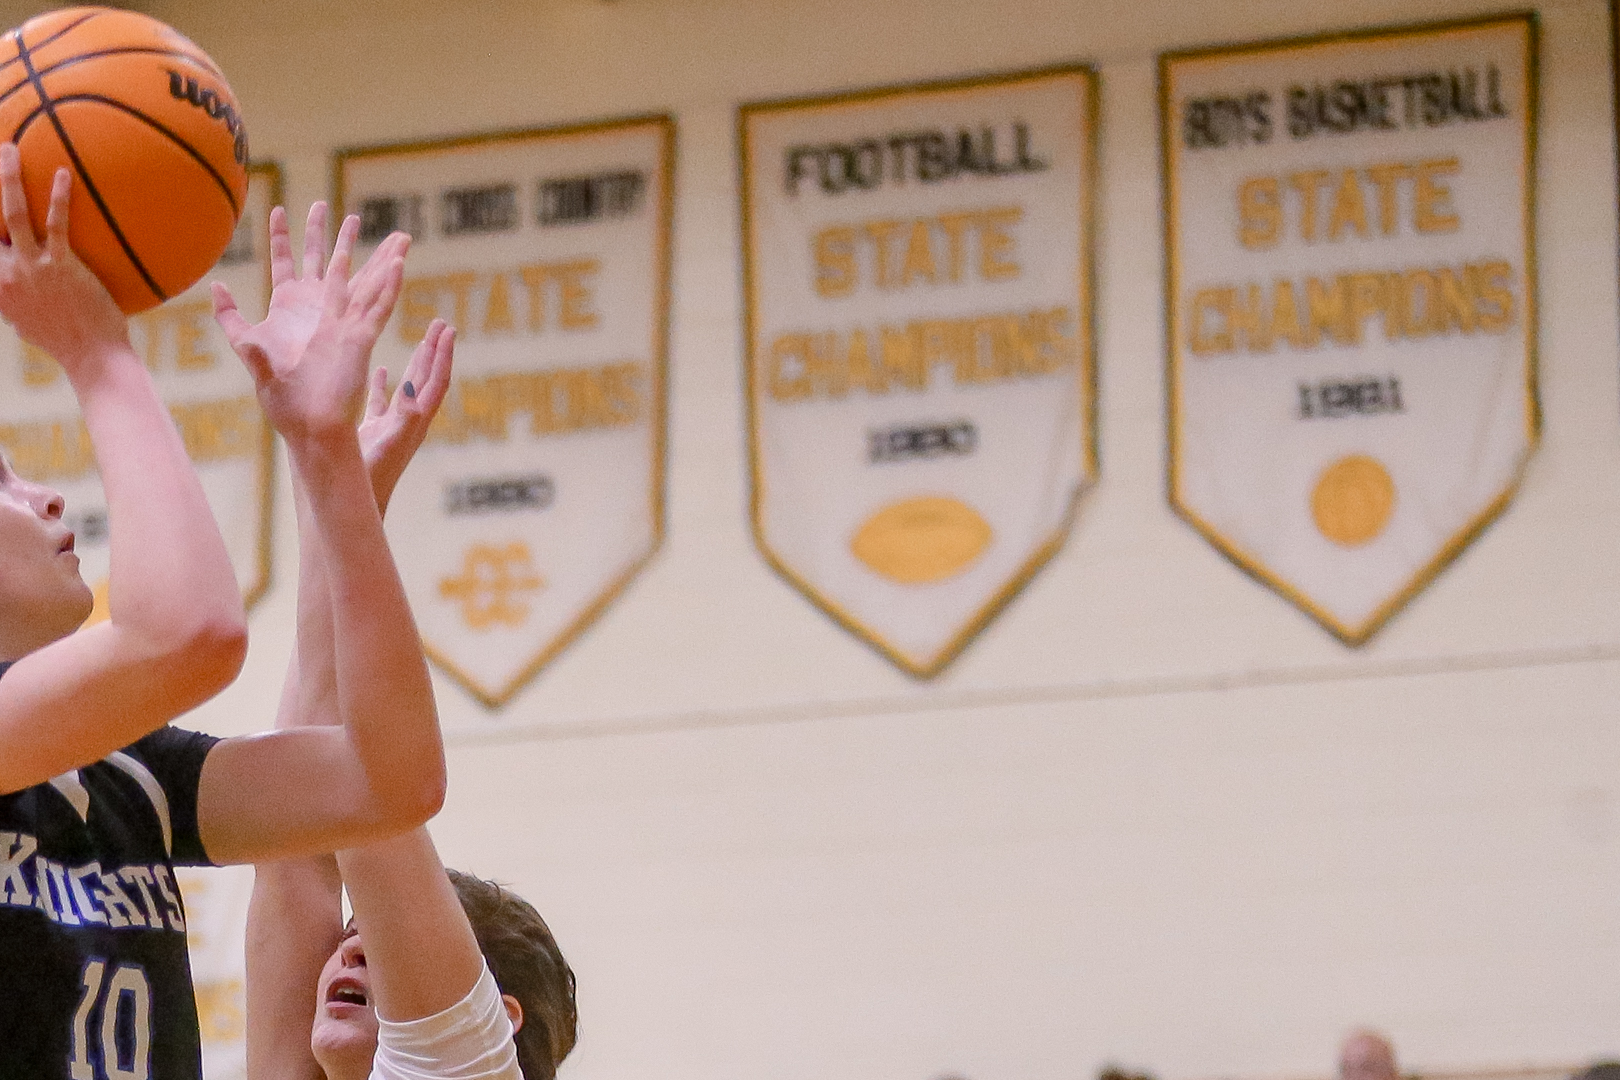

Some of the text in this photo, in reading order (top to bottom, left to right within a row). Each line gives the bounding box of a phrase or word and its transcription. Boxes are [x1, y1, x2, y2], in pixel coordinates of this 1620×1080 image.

[1183, 62, 1510, 149] BOYS BASKETBALL
[783, 117, 1052, 200] FOOTBALL
[1236, 155, 1463, 250] STATE
[398, 254, 601, 345] STATE
[811, 206, 1026, 300] STATE
[766, 306, 1078, 404] CHAMPIONS
[1186, 260, 1517, 358] CHAMPIONS
